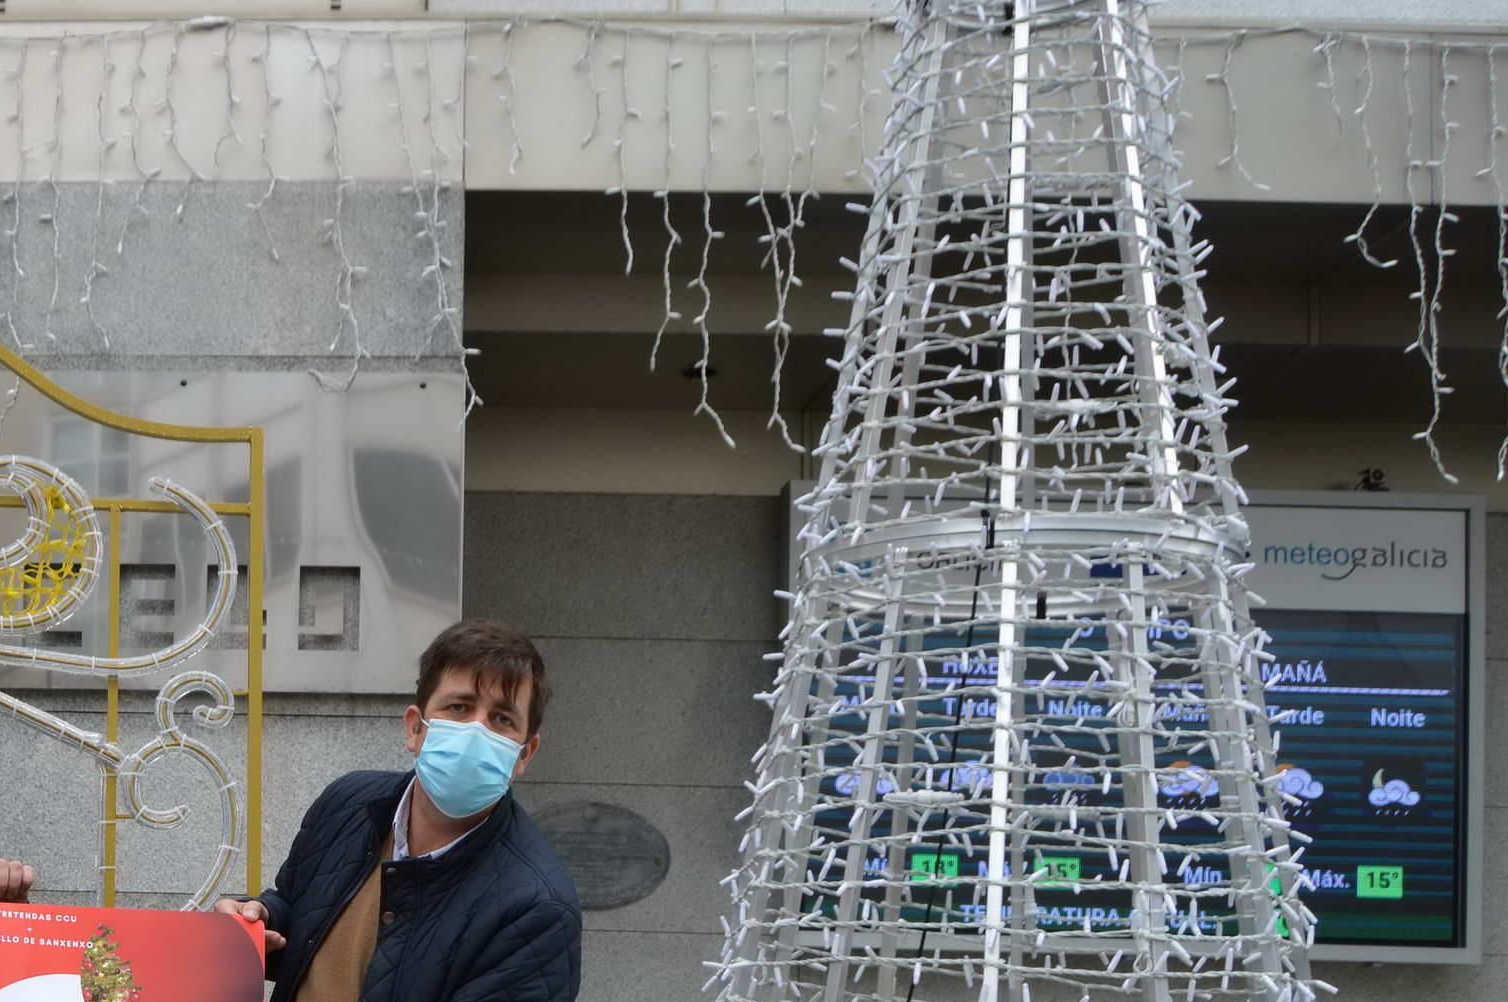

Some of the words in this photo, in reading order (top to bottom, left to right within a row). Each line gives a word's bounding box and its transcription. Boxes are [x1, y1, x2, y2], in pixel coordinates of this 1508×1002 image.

[1264, 541, 1447, 580] meteogalicia
[1370, 708, 1426, 728] Noite
[1367, 872, 1399, 889] 15°
[55, 914, 77, 922] CCU
[23, 936, 35, 944] DE
[39, 938, 94, 949] SANXENXO
